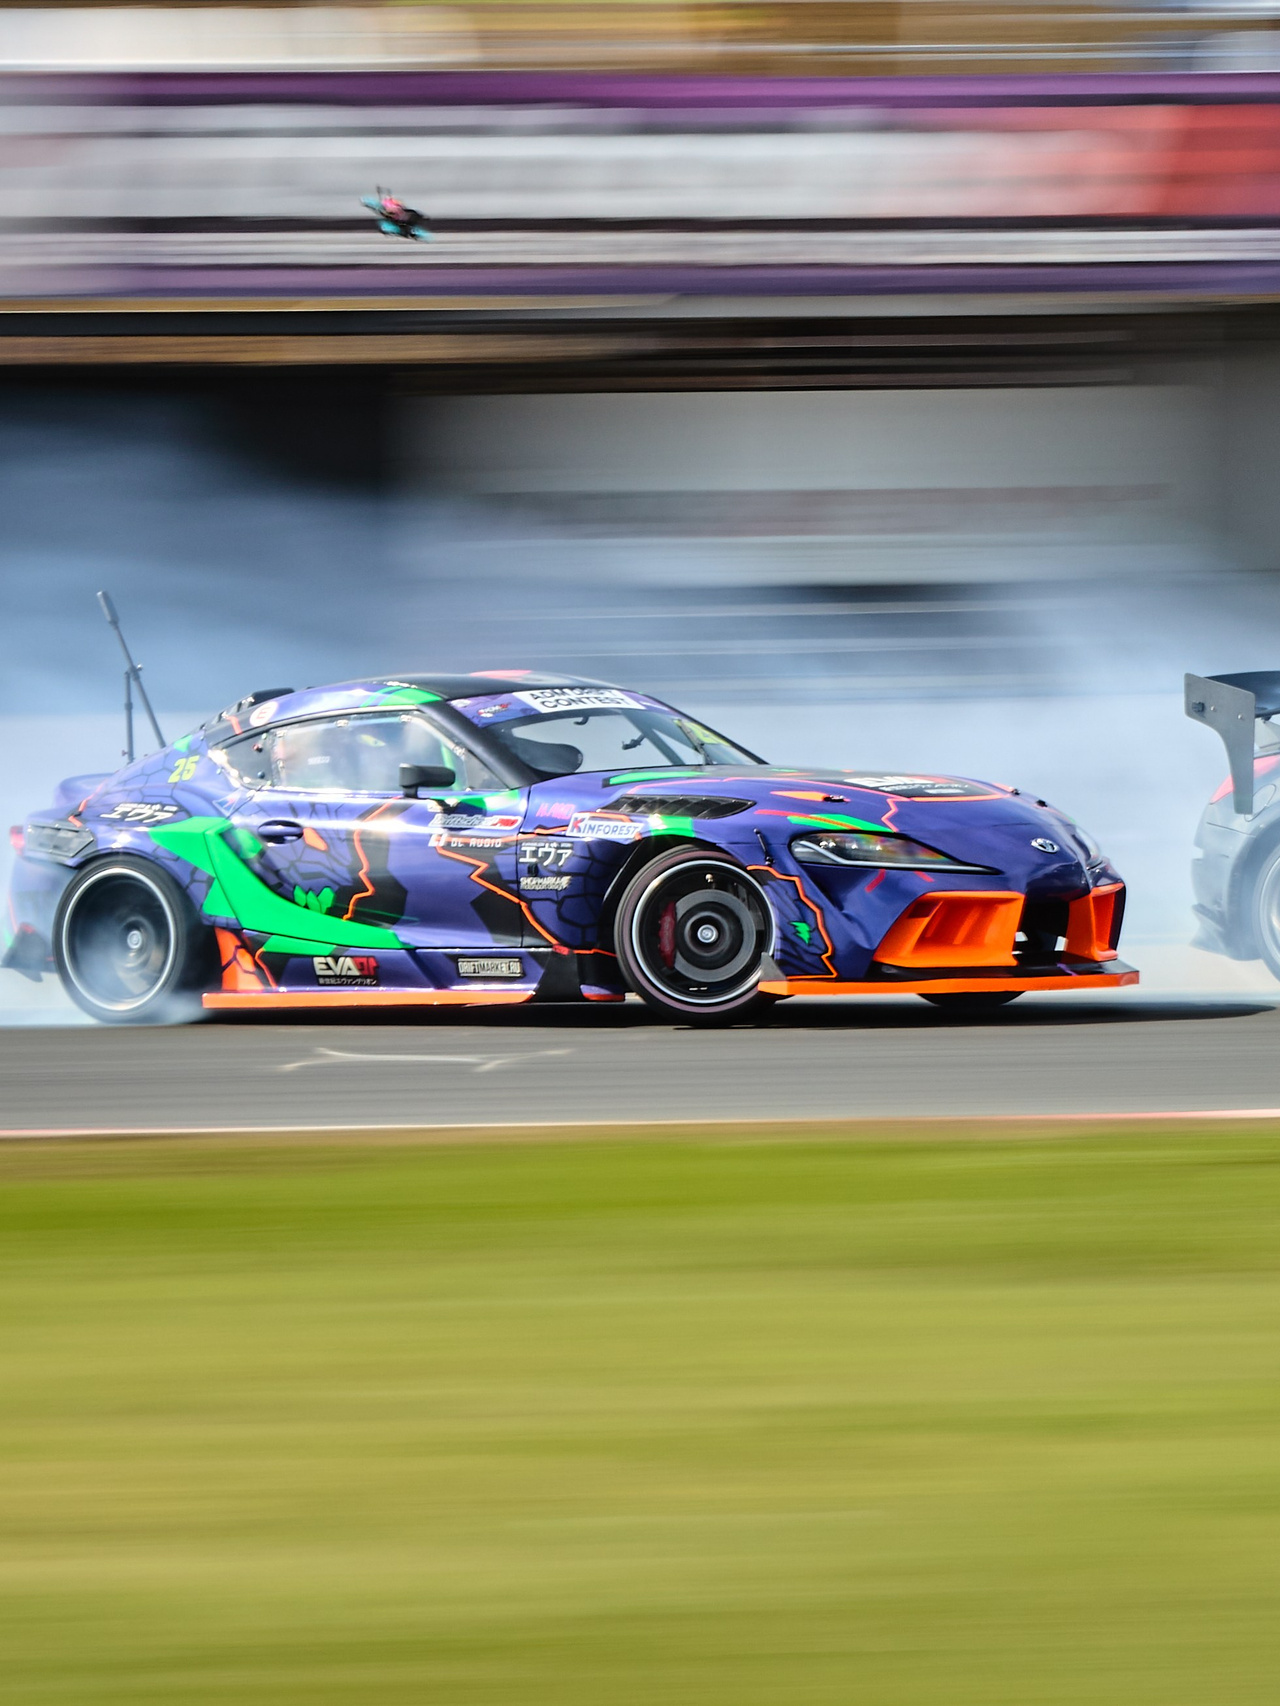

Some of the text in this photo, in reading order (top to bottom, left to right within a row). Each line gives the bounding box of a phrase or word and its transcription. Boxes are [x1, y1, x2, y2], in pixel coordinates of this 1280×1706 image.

[530, 688, 568, 700] ADM
[541, 696, 632, 709] CONTEST
[168, 755, 199, 783] 25
[570, 816, 638, 836] KINFOREST
[469, 838, 502, 848] AUDIO
[519, 842, 573, 866] エヴァ
